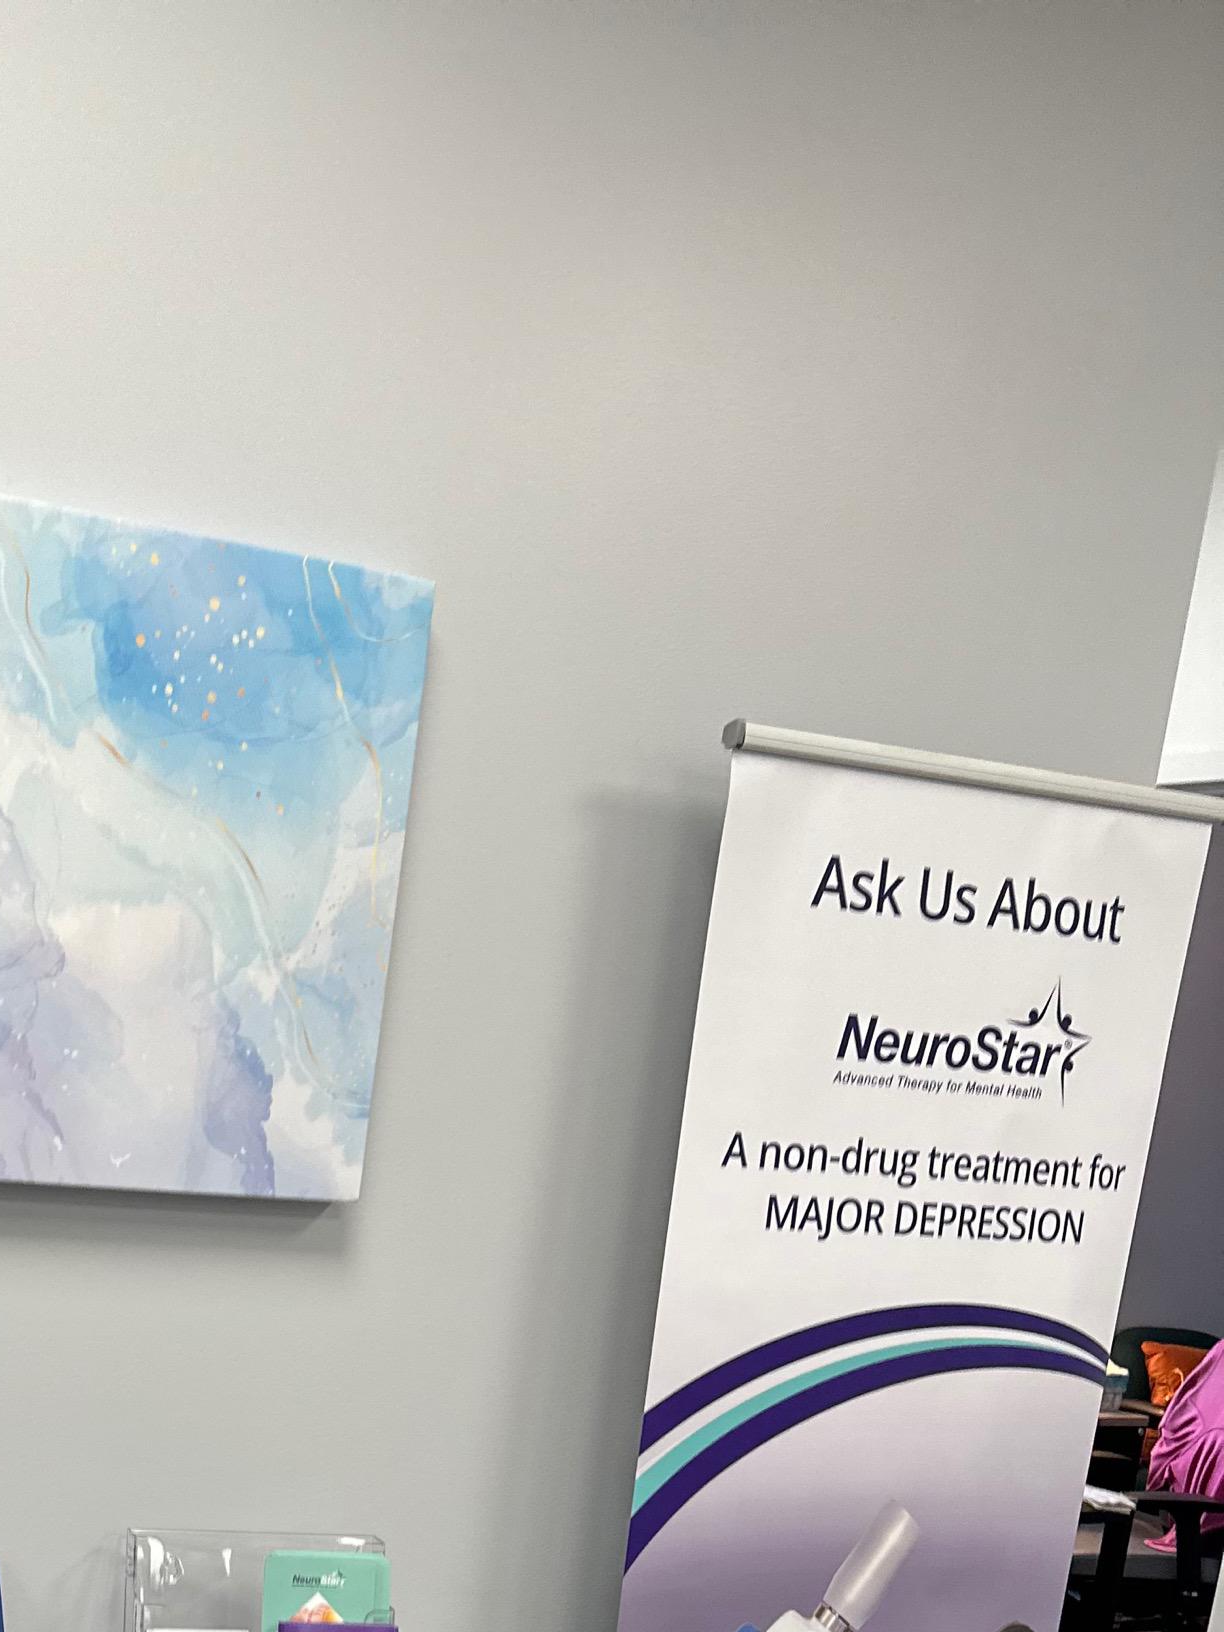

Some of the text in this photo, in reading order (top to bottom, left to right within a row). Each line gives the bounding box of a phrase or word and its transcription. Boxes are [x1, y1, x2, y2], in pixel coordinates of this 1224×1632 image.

[810, 854, 1125, 944] Ask Us About
[832, 1070, 1043, 1100] Advanced Therapy for Mental Health
[721, 1131, 1126, 1192] A non-drug treatment for
[765, 1193, 1085, 1244] MAJOR DEPRESSION
